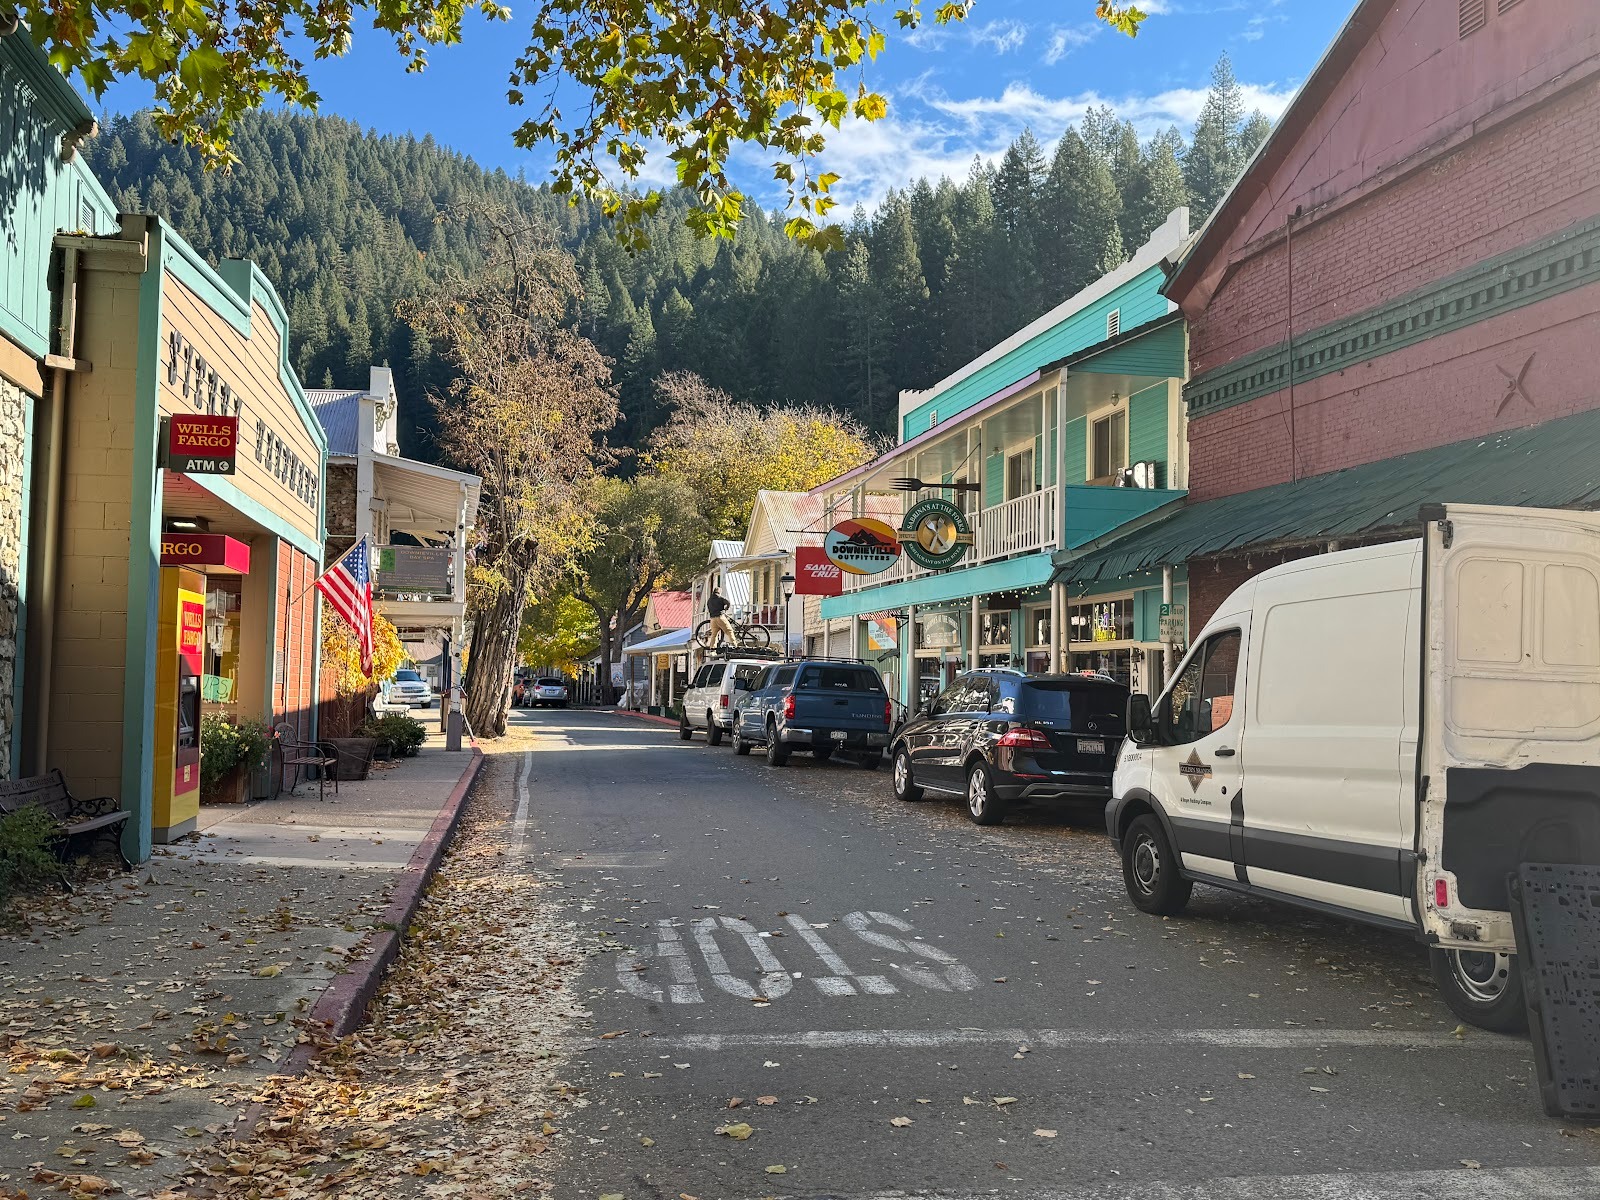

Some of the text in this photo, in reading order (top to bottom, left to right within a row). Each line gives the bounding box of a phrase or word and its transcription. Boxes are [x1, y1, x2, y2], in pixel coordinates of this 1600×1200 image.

[177, 423, 231, 436] WELLS
[177, 435, 231, 447] FARGO
[186, 459, 215, 471] ATM
[907, 504, 931, 529] SABRINA'S
[940, 504, 952, 515] THE
[832, 546, 896, 555] DOWNIEVILLE
[908, 543, 933, 564] RESTAURANT
[1161, 605, 1168, 615] 2
[184, 611, 202, 628] WELLS
[1160, 619, 1184, 628] PARKING
[183, 630, 201, 646] FARGO
[615, 911, 984, 1003] STOP
